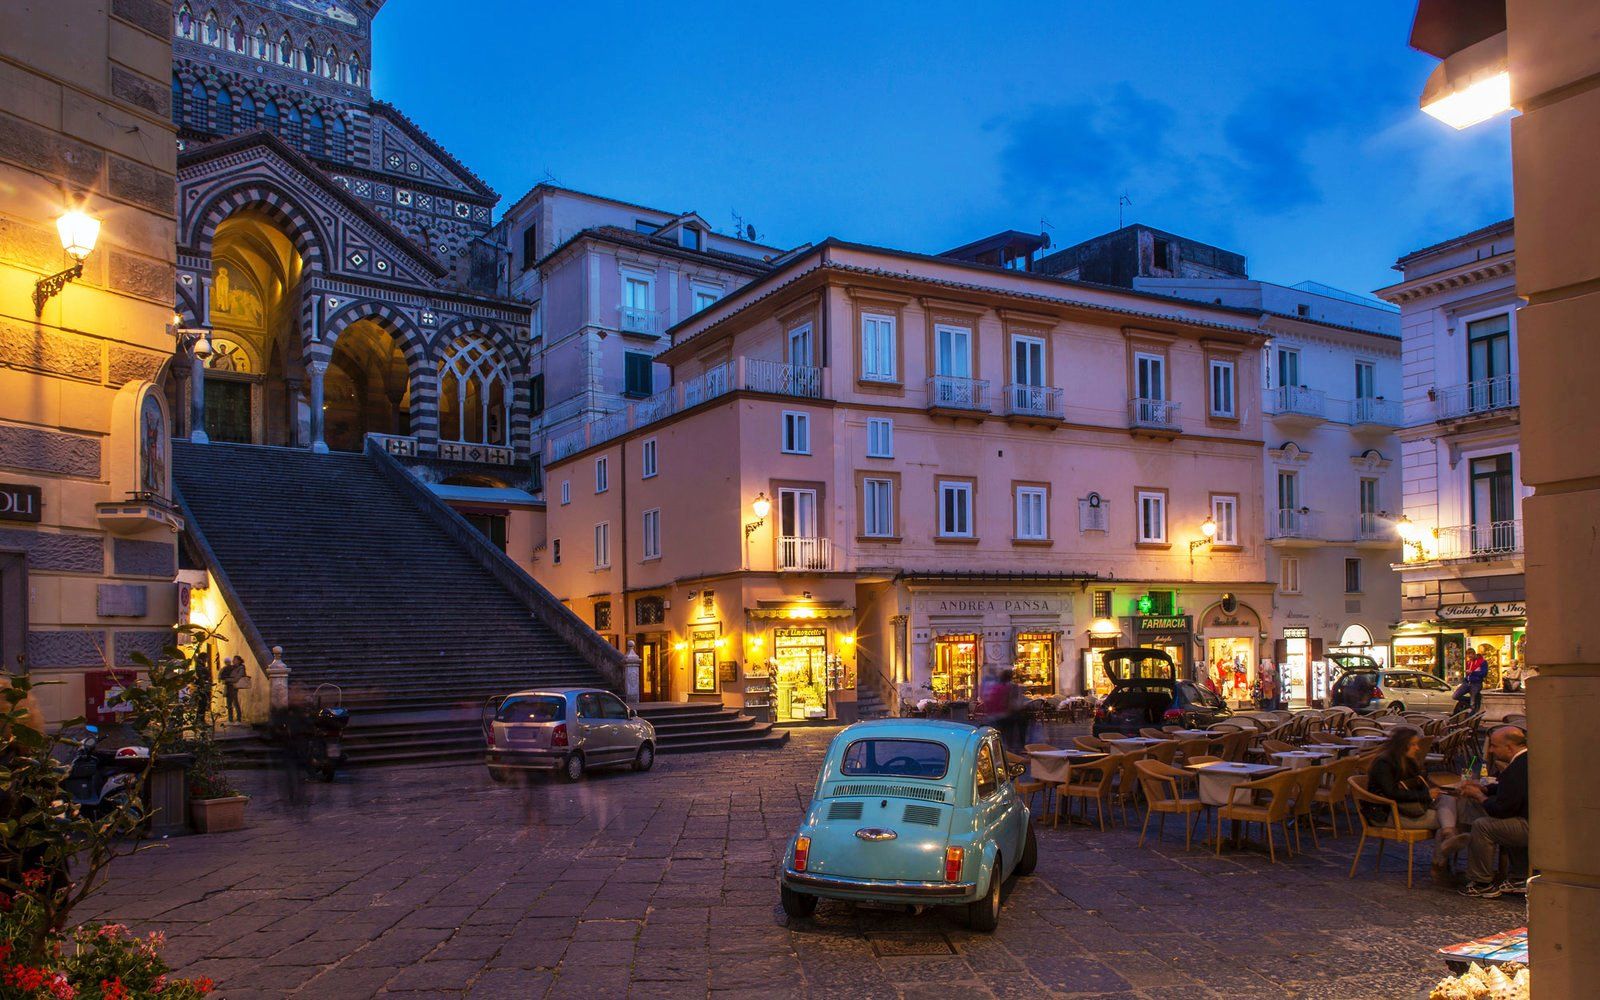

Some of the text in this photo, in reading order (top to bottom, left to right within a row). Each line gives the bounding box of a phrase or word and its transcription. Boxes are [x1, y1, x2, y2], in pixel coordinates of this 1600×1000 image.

[940, 600, 1049, 611] ANDREA PANSA
[1445, 605, 1488, 617] Holiday
[1141, 618, 1186, 629] FARMACIA
